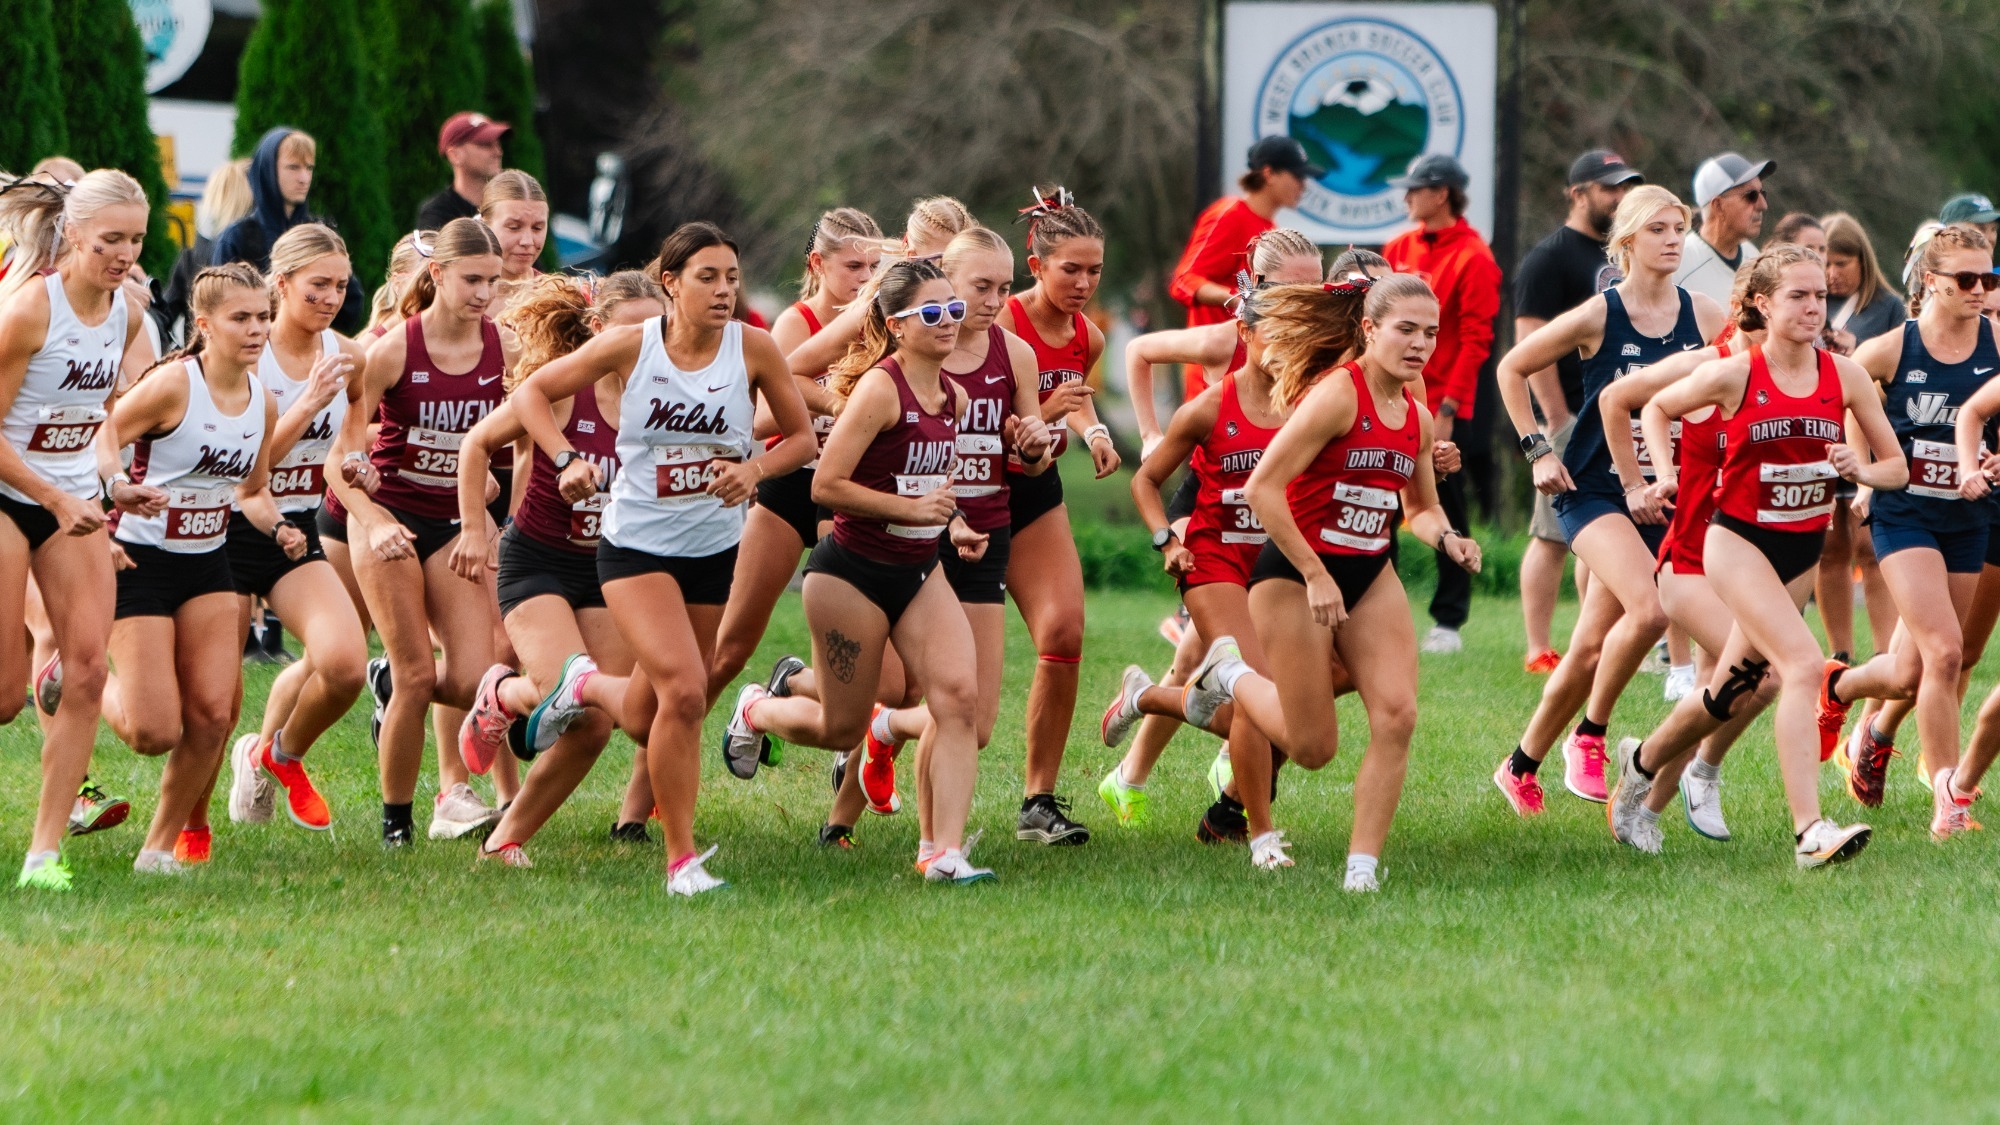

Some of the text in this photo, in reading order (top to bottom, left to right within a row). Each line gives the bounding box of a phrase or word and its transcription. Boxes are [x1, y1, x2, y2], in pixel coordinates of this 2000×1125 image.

[1367, 30, 1432, 76] SOCCER
[58, 358, 115, 391] Walsh
[419, 400, 495, 432] HAVEN
[643, 397, 729, 435] Walsh
[955, 398, 1003, 432] VEN
[41, 425, 95, 449] 3654
[1751, 420, 1791, 442] DAVIS
[1804, 419, 1840, 442] ELKINS
[190, 444, 255, 479] Walsh
[413, 449, 459, 474] 325
[952, 457, 991, 481] 263
[1223, 451, 1261, 472] DAVIS
[1347, 450, 1386, 468] DAVIS
[669, 464, 716, 492] 364
[1922, 462, 1960, 485] 321
[1770, 482, 1827, 508] 3075
[177, 510, 226, 536] 3658
[1337, 506, 1387, 535] 3081
